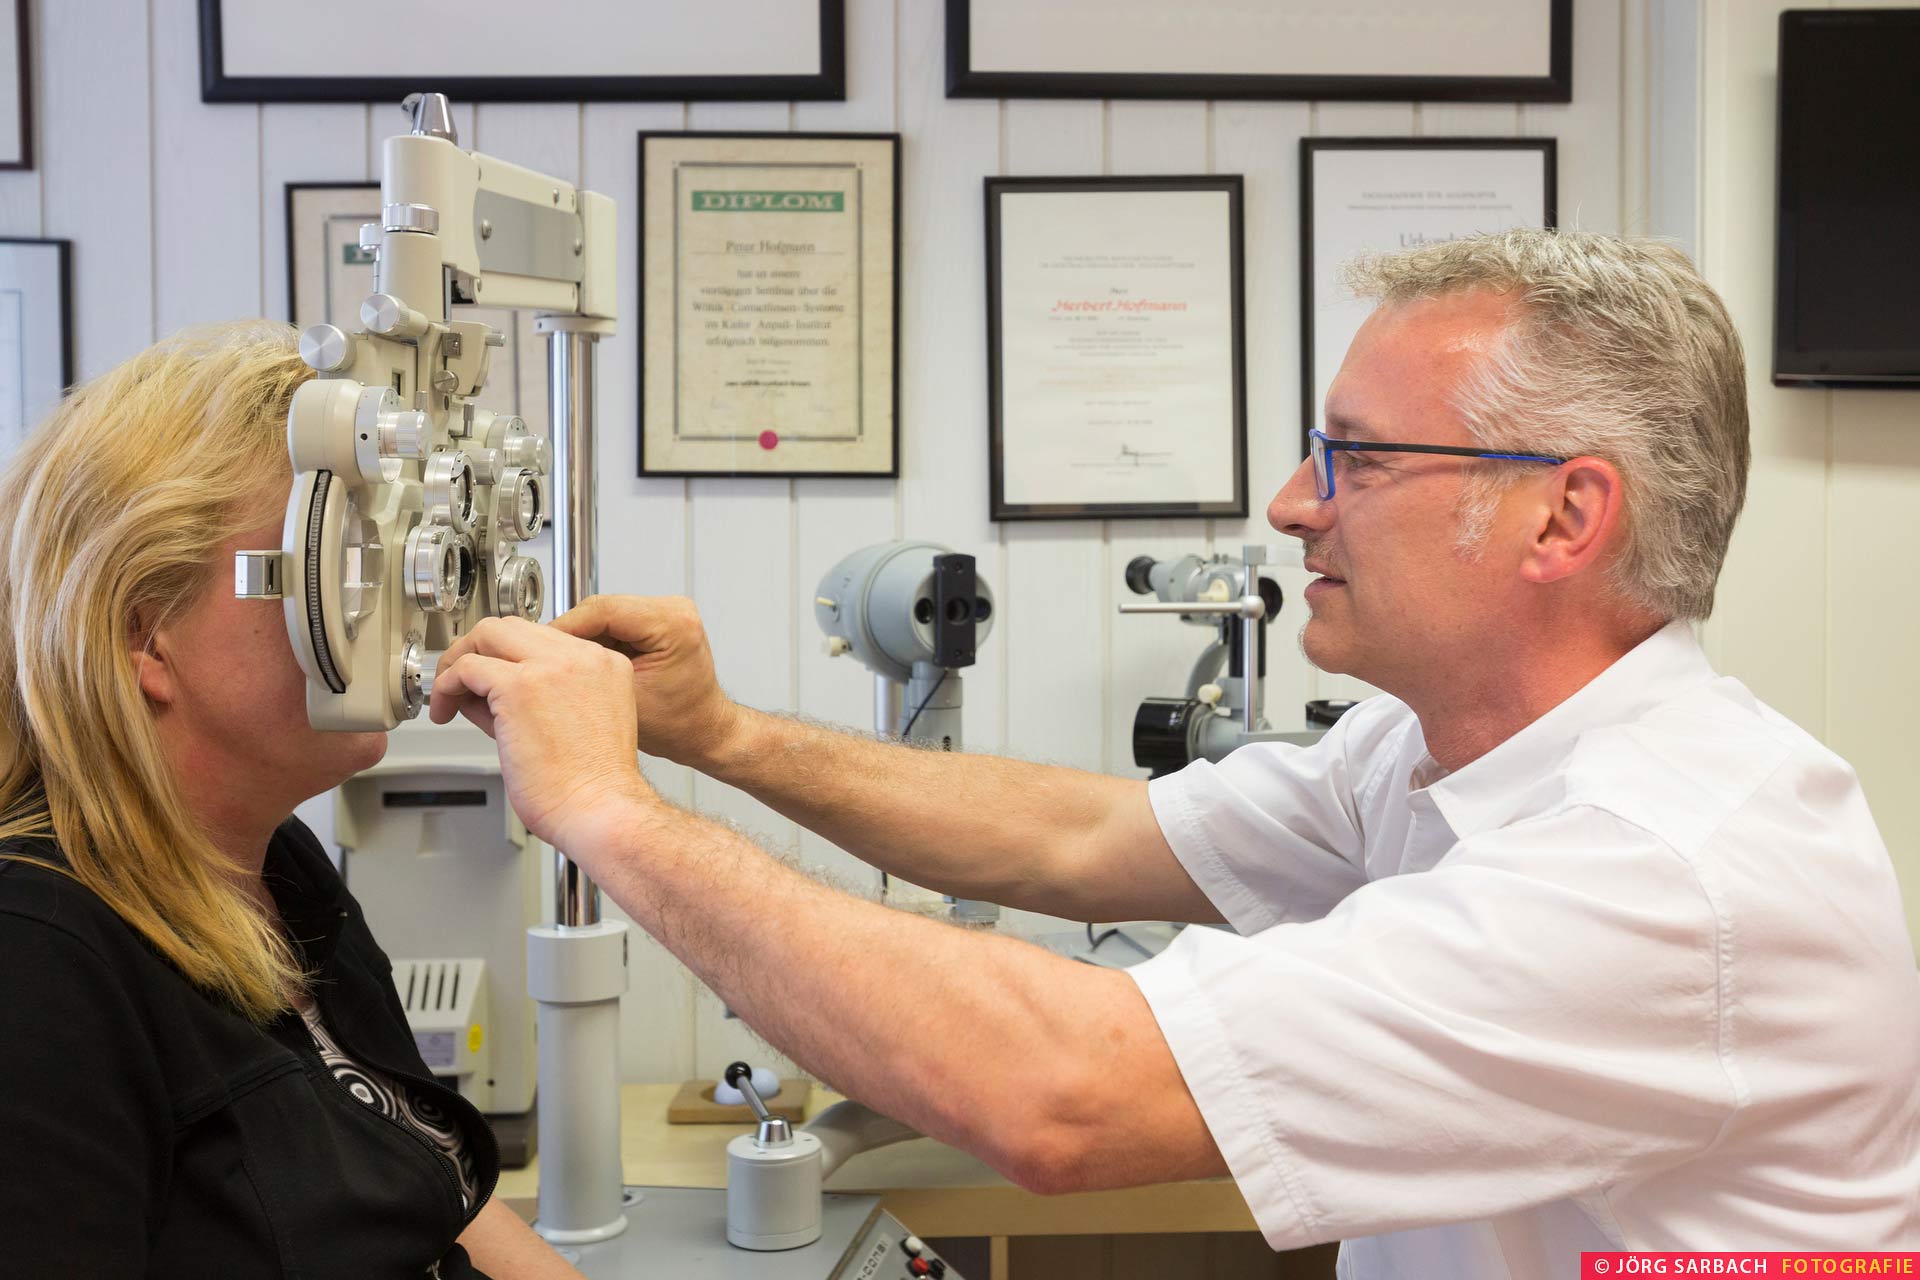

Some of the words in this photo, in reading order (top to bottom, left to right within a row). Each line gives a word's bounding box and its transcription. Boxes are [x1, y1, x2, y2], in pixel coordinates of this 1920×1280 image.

[701, 193, 836, 209] DIPLOM
[725, 240, 755, 252] Peter
[822, 285, 838, 296] die
[1051, 299, 1113, 313] Herbert
[1115, 299, 1188, 314] Hofmann
